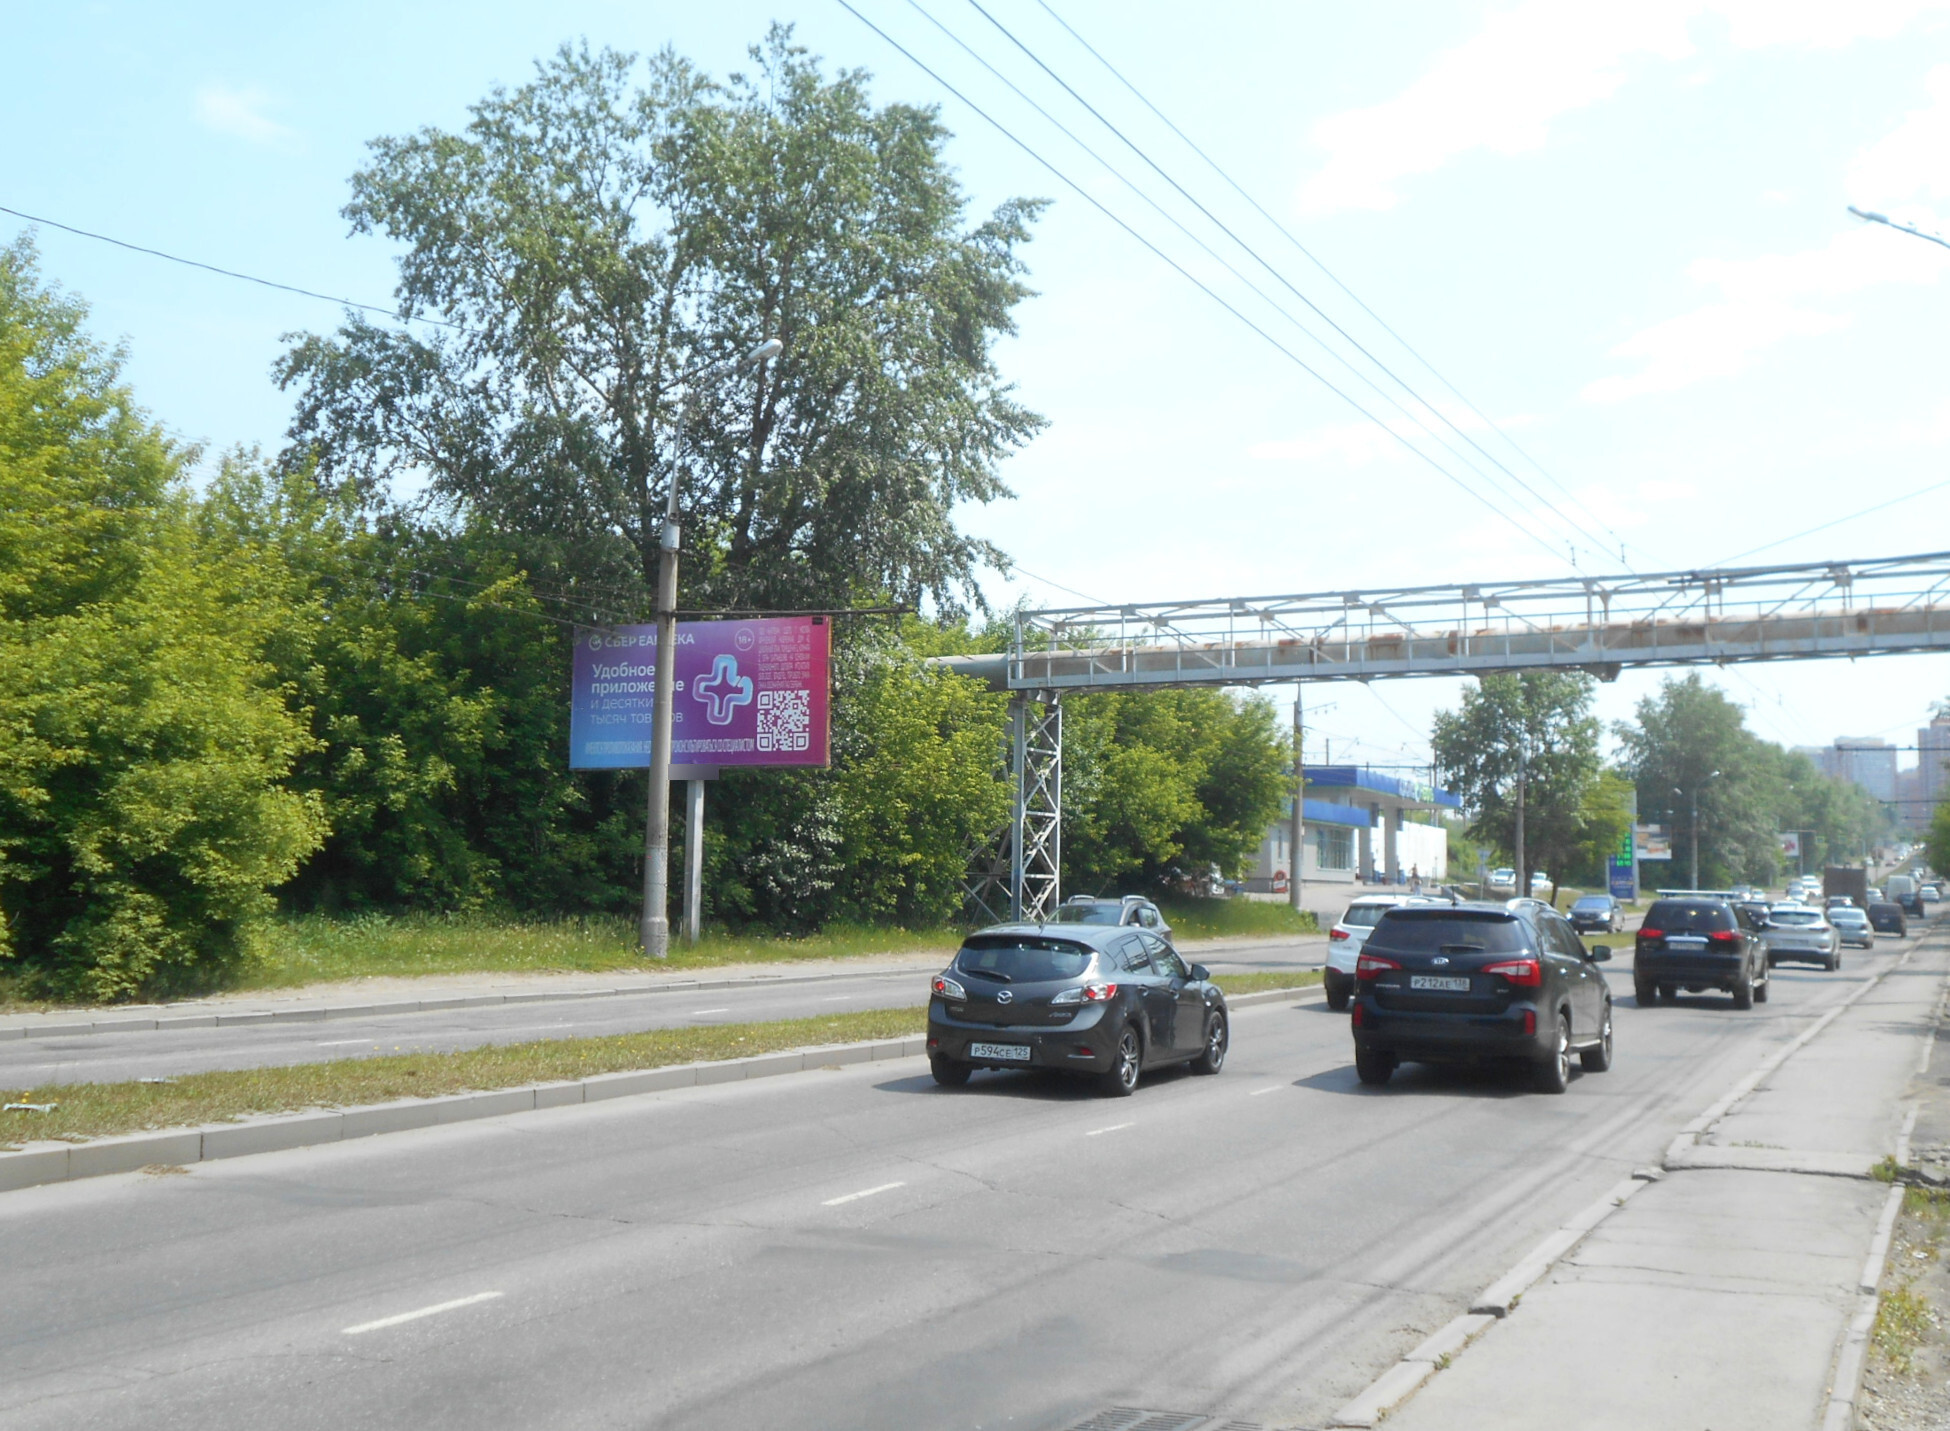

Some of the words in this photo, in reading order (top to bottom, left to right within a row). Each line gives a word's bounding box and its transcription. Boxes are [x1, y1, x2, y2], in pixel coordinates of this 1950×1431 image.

[592, 661, 656, 680] Удобное
[601, 697, 654, 711] десятки
[590, 714, 627, 725] тысяч
[1014, 1046, 1029, 1057] 125
